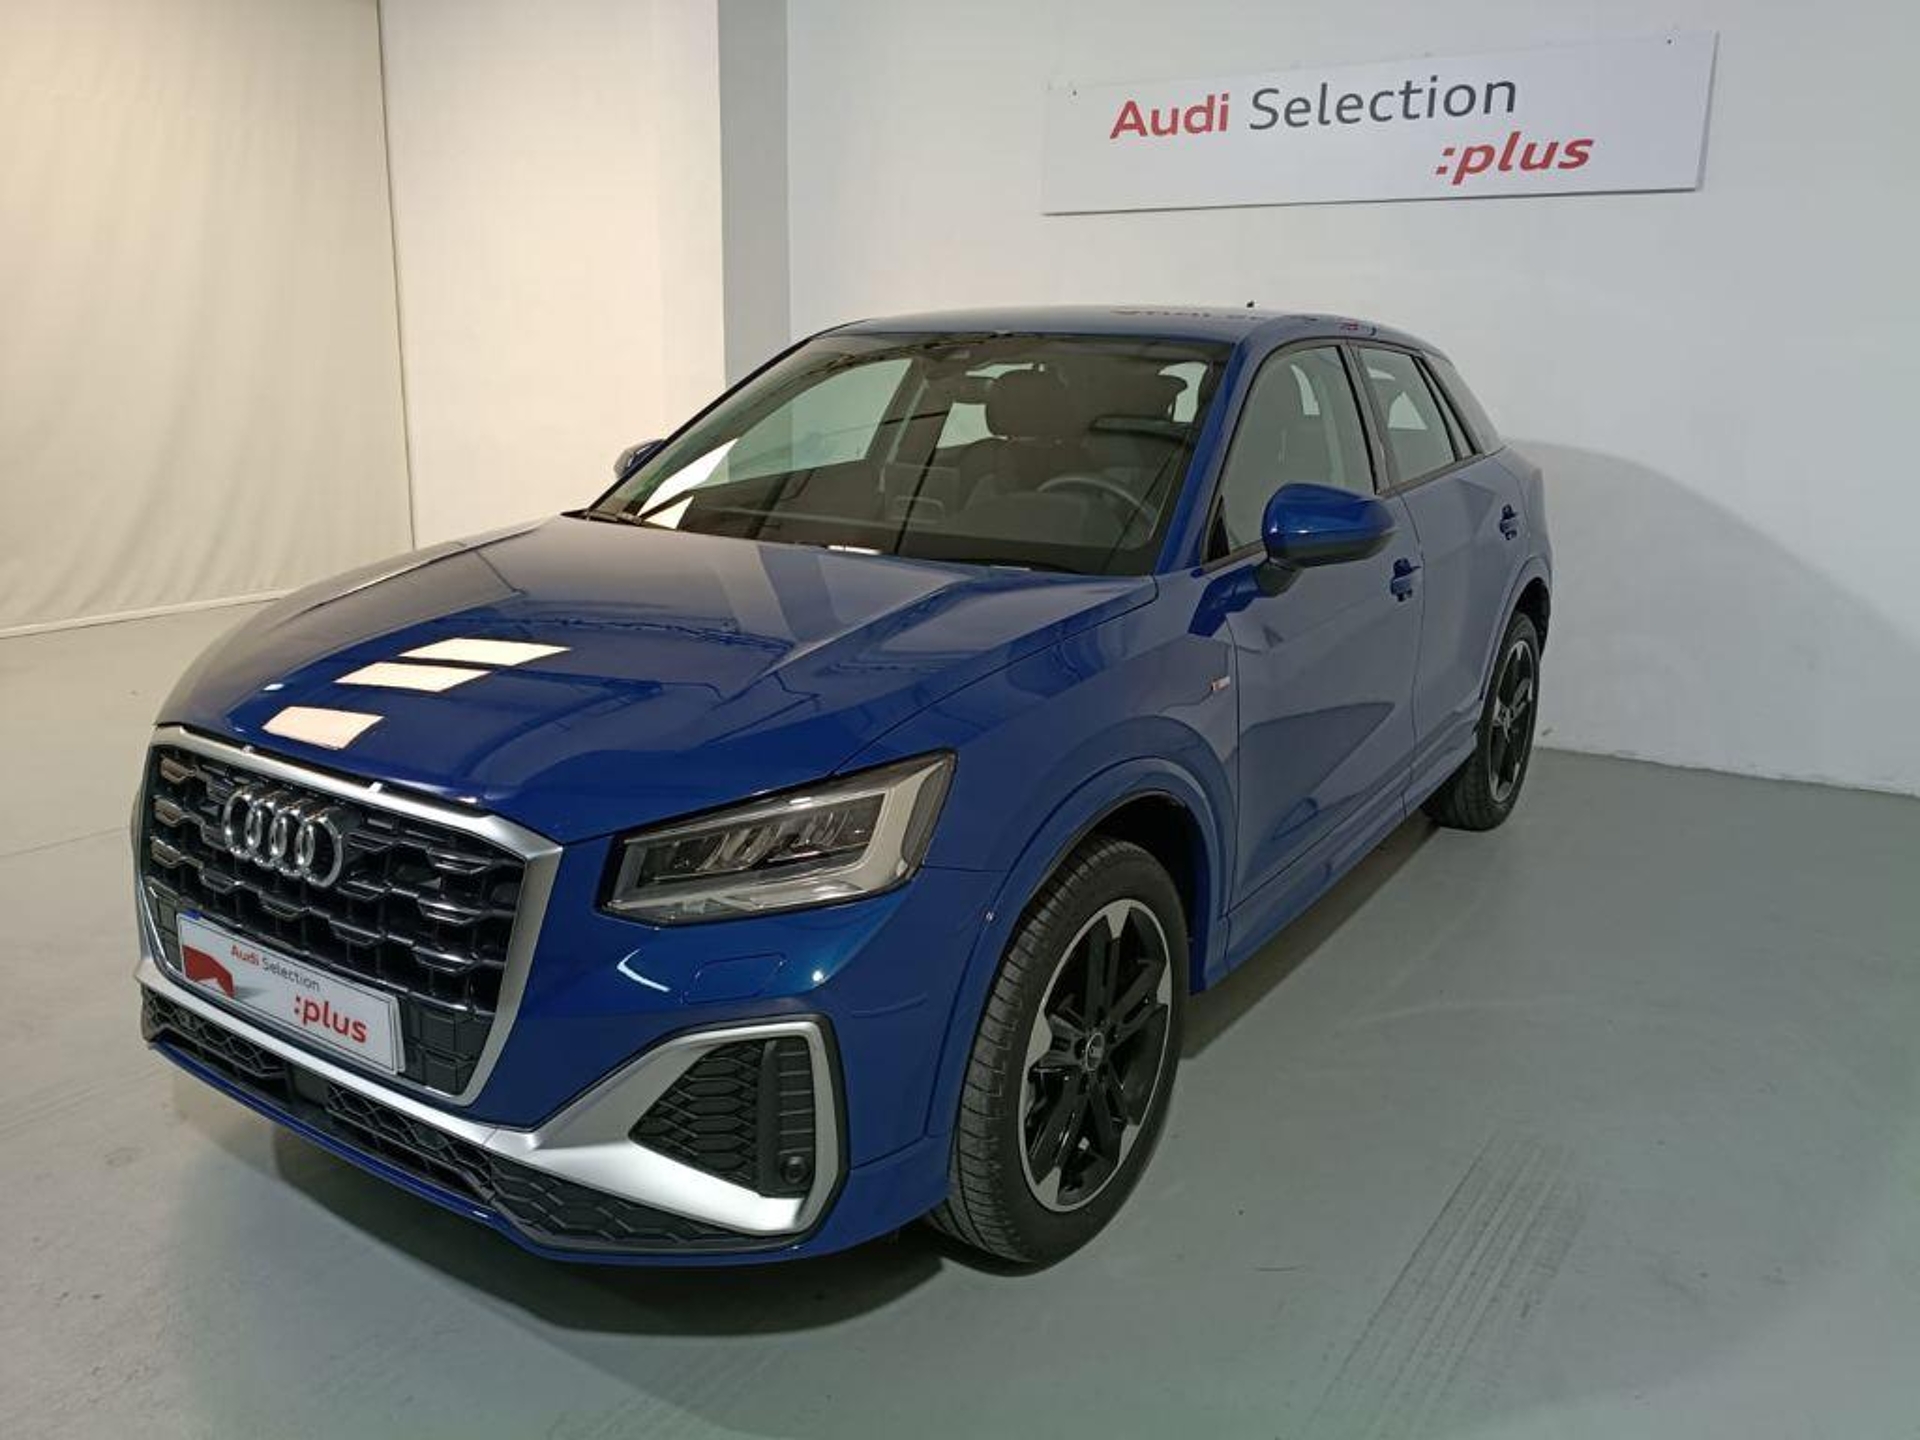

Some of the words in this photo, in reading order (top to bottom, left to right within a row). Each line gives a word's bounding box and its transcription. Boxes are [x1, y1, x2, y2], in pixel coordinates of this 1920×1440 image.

[1109, 92, 1230, 140] Audi
[1248, 75, 1517, 131] Selection
[1435, 131, 1594, 185] :plus
[230, 944, 260, 967] Audi
[262, 957, 320, 992] Selection
[294, 995, 367, 1044] :plus
